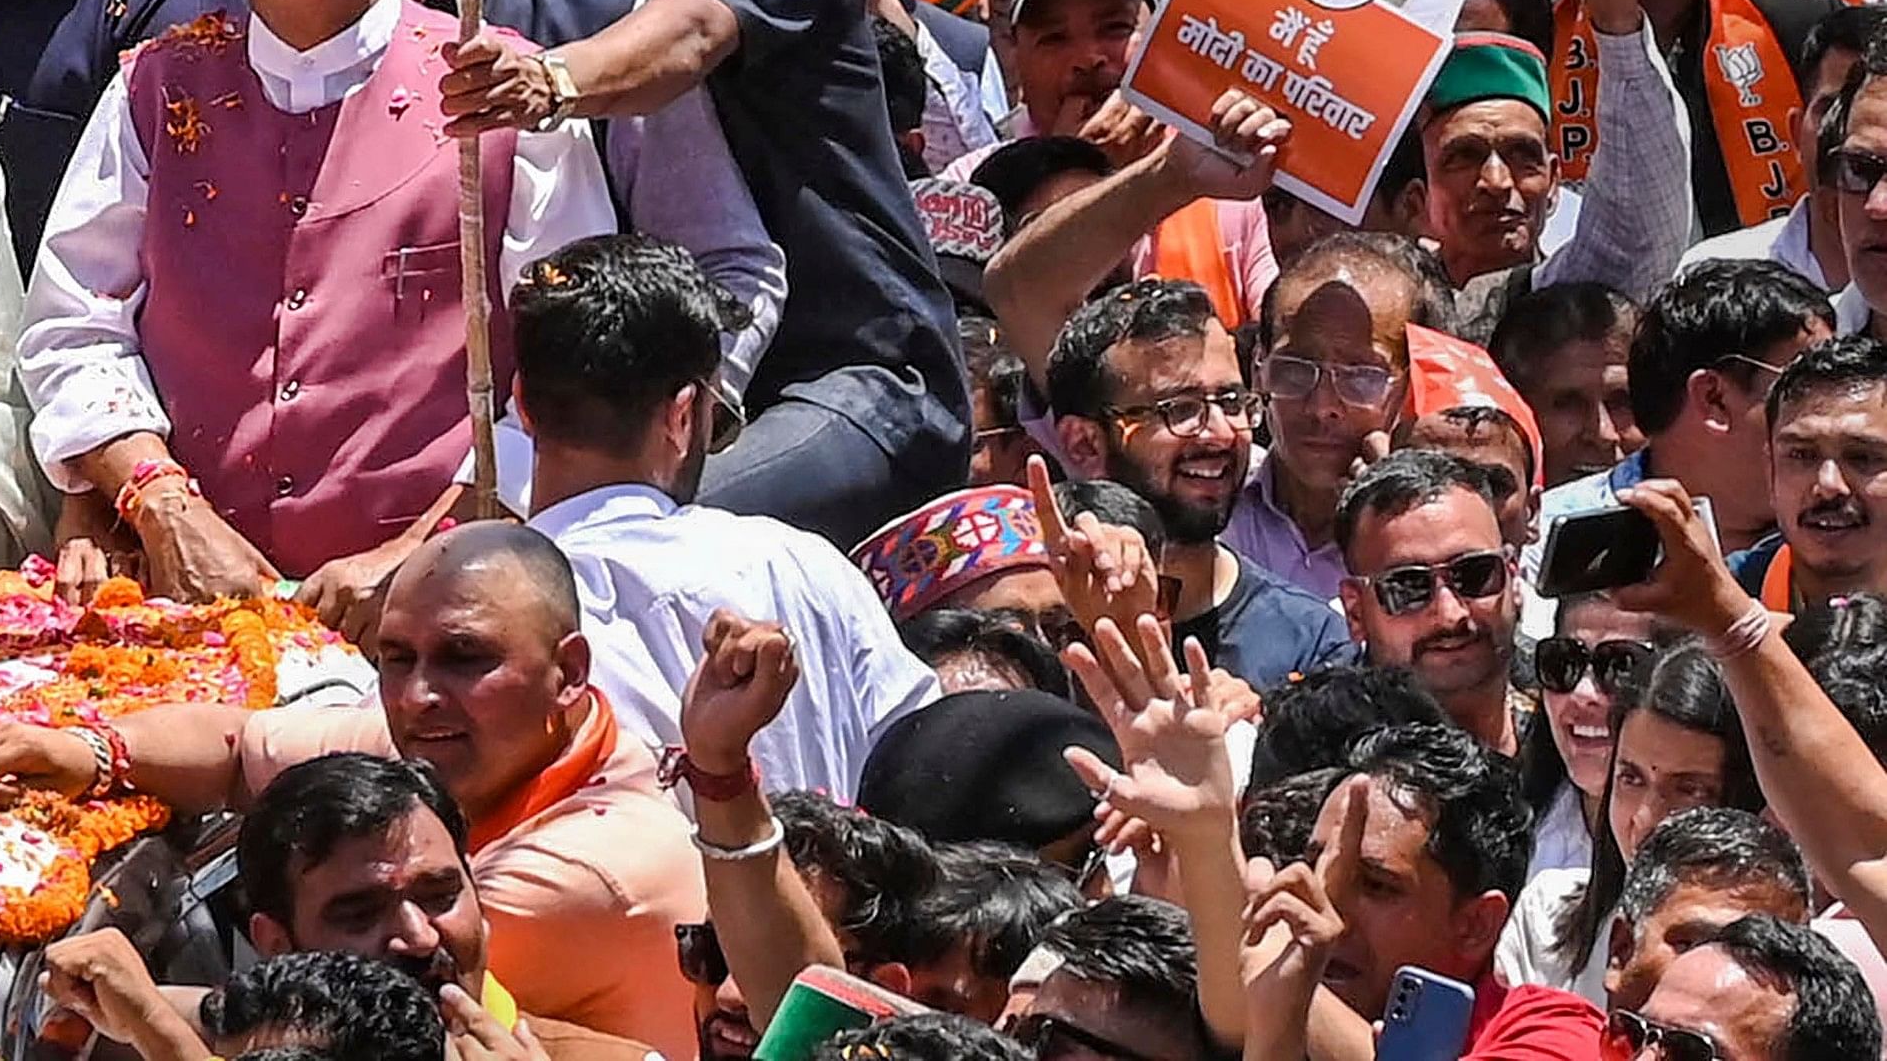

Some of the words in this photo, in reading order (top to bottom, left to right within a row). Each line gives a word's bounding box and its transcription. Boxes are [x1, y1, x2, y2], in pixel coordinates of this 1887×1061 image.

[1177, 13, 1245, 70] मोदी
[1241, 49, 1285, 92] का
[1282, 70, 1377, 140] परिवार
[1269, 6, 1311, 48] मैं
[1297, 19, 1334, 70] हूँ
